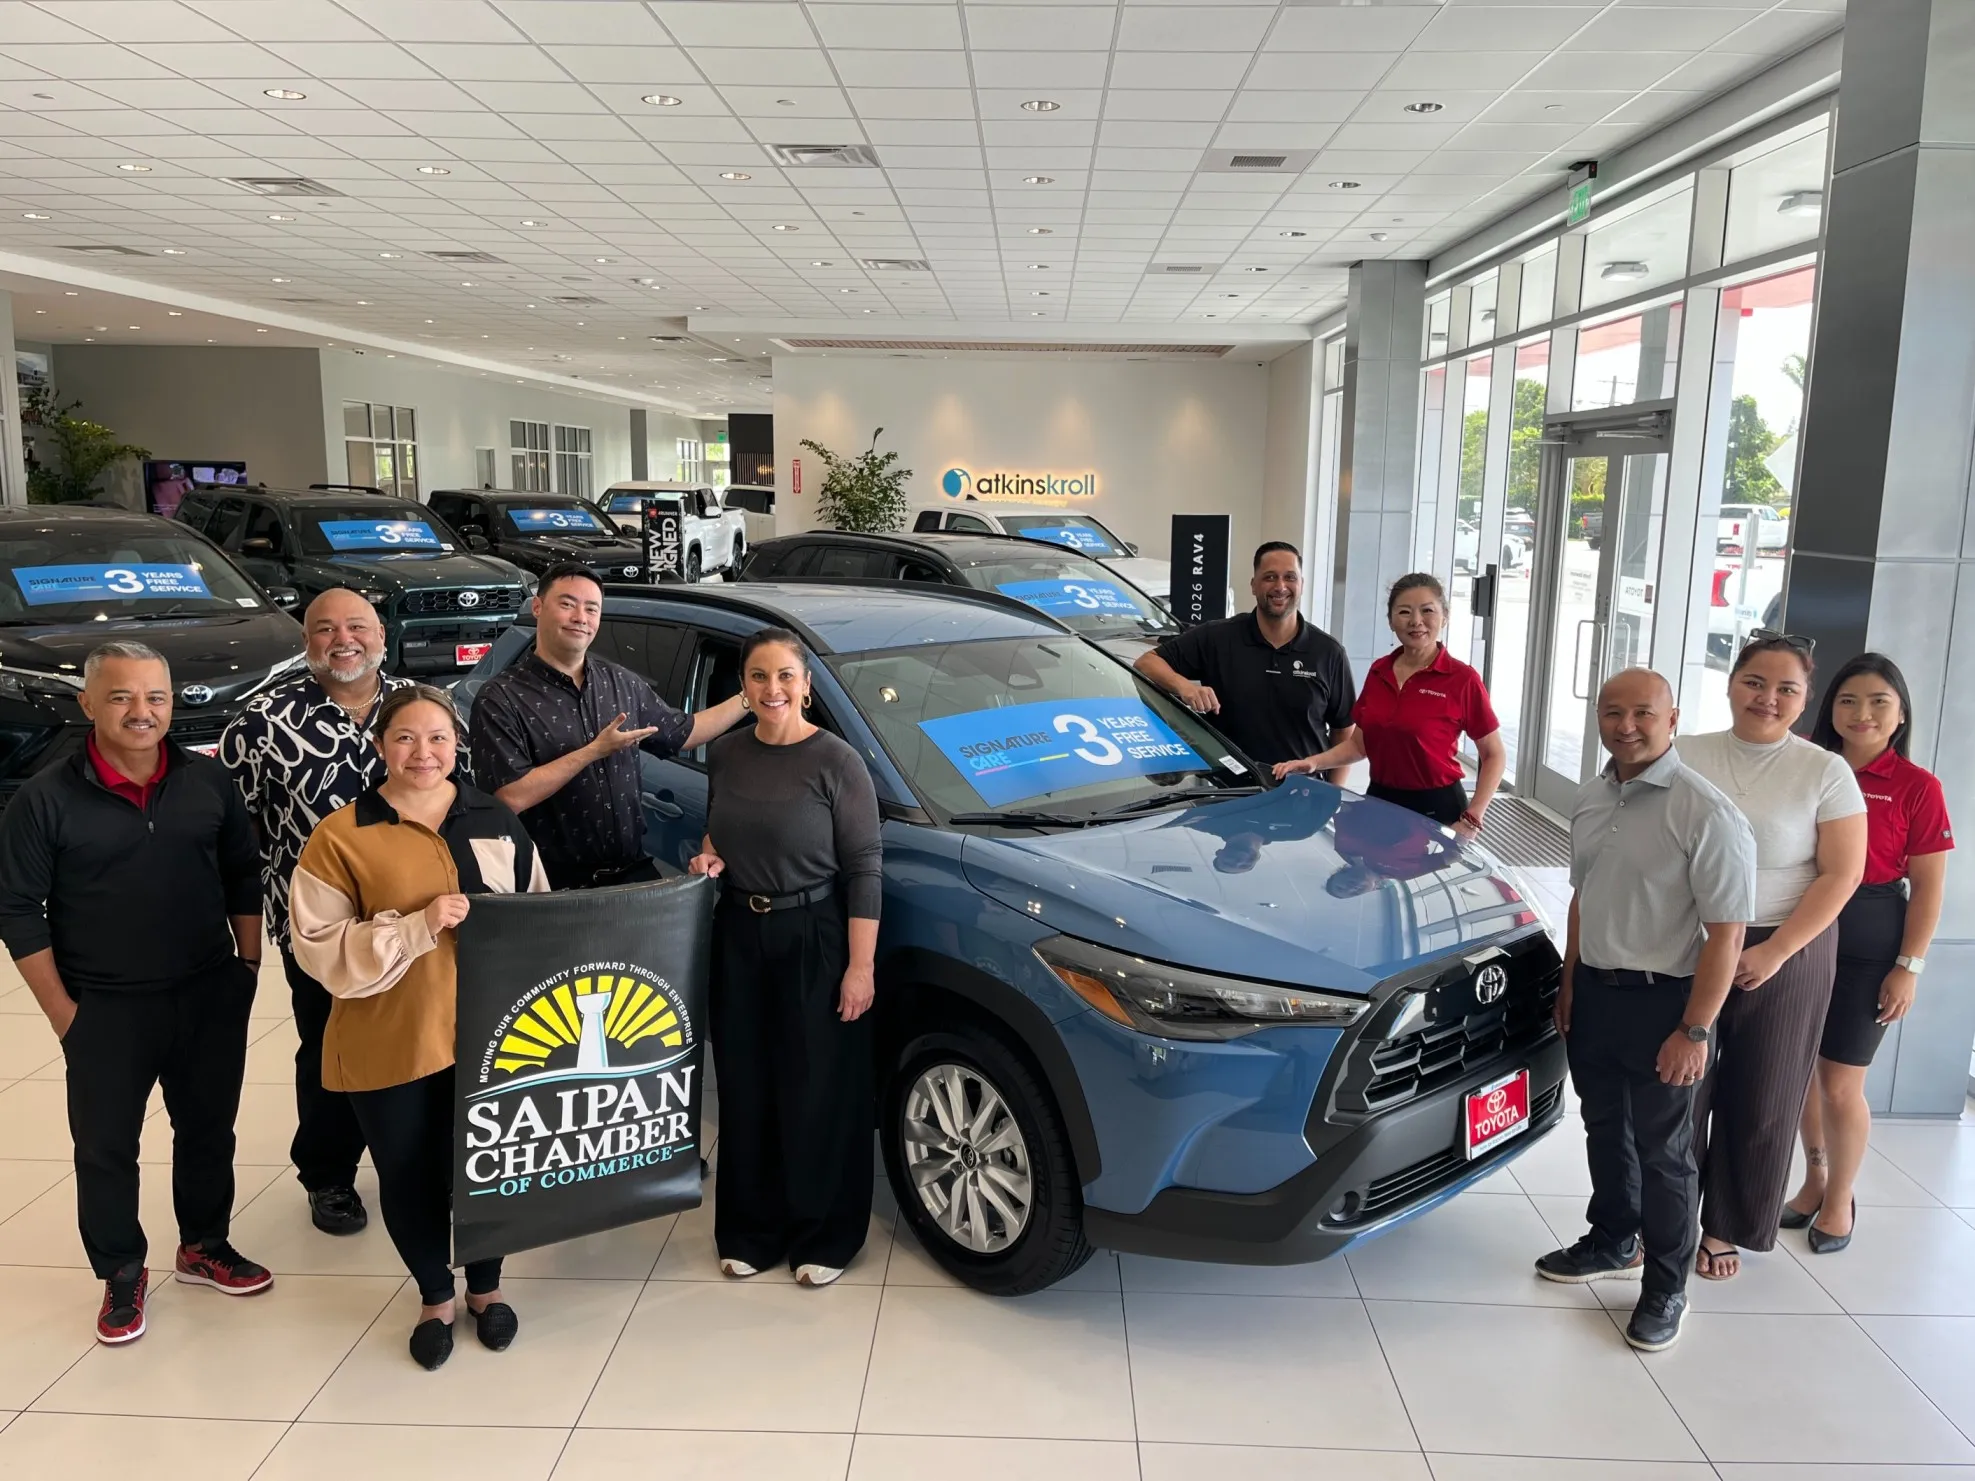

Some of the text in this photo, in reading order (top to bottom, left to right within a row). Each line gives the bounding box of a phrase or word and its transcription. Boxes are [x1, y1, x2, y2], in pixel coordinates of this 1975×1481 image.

[977, 473, 1095, 495] atkinskroll
[549, 513, 569, 527] 3
[375, 525, 402, 543] 3
[1060, 531, 1082, 548] 3
[648, 529, 667, 571] NEW
[29, 576, 96, 585] SIGNATURE
[104, 569, 144, 593] 3
[1191, 533, 1204, 621] 2026 RAV4
[150, 585, 202, 593] SERVICE
[1063, 585, 1100, 609] 3
[1097, 716, 1148, 730] YEARS
[959, 731, 1052, 758] SIGNATURE
[1053, 714, 1123, 766] 3
[1114, 730, 1154, 744] FREE
[969, 752, 1013, 770] CARE
[1127, 744, 1190, 760] SERVICE
[1867, 793, 1892, 802] TOYOTA
[480, 962, 694, 1084] MOVING OUR COMMUNITY FORWARD THROUGH ENTERPRISE
[466, 1065, 696, 1149] SAIPAN
[1475, 1105, 1519, 1139] TOYOTA
[465, 1110, 692, 1183] CHAMBER
[499, 1146, 673, 1196] OF COMMERCE
